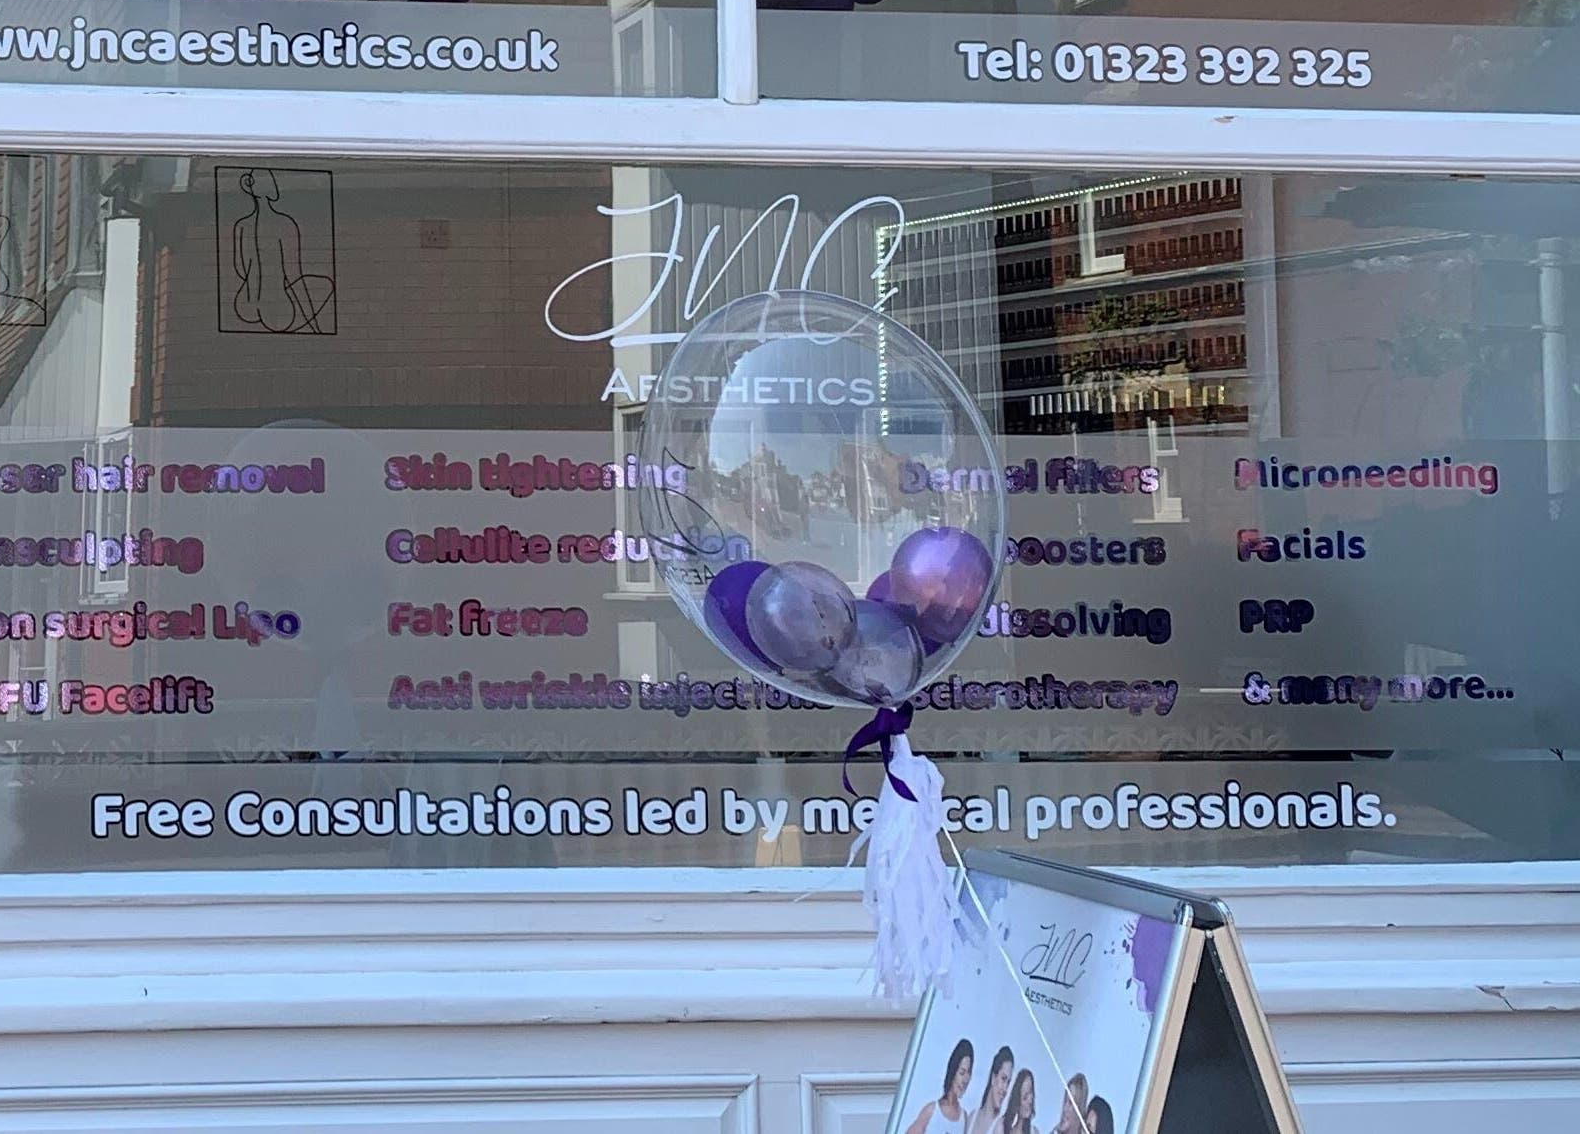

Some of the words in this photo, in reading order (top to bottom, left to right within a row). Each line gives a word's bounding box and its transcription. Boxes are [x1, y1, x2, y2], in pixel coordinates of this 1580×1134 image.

[955, 39, 1044, 82] Tel:
[1052, 42, 1189, 86] 01323
[1196, 45, 1281, 87] 392
[1290, 47, 1374, 89] 325
[545, 194, 904, 346] JNC
[72, 453, 155, 493] hair
[161, 457, 325, 493] removal
[385, 453, 472, 491] Skin
[478, 452, 688, 498] tightening
[1045, 456, 1162, 494] Fillers
[1235, 457, 1500, 495] Microneedling
[385, 525, 552, 563] Cellulite
[1236, 527, 1367, 562] Facials
[43, 601, 207, 648] surgical
[213, 601, 302, 646] Lipo
[388, 602, 453, 637] Fat
[458, 598, 589, 637] freeze
[1238, 599, 1315, 633] PRP
[58, 674, 215, 714] Facelift
[387, 670, 473, 710] Anti
[478, 670, 633, 710] wrinkle
[1242, 671, 1273, 706] &
[1277, 674, 1383, 711] many
[1387, 674, 1515, 703] more...
[92, 792, 213, 837] Free
[224, 785, 611, 837] Consultations
[622, 787, 710, 835] led
[722, 787, 789, 843] by
[802, 786, 1010, 835] mecal
[1025, 782, 1397, 839] professionals.
